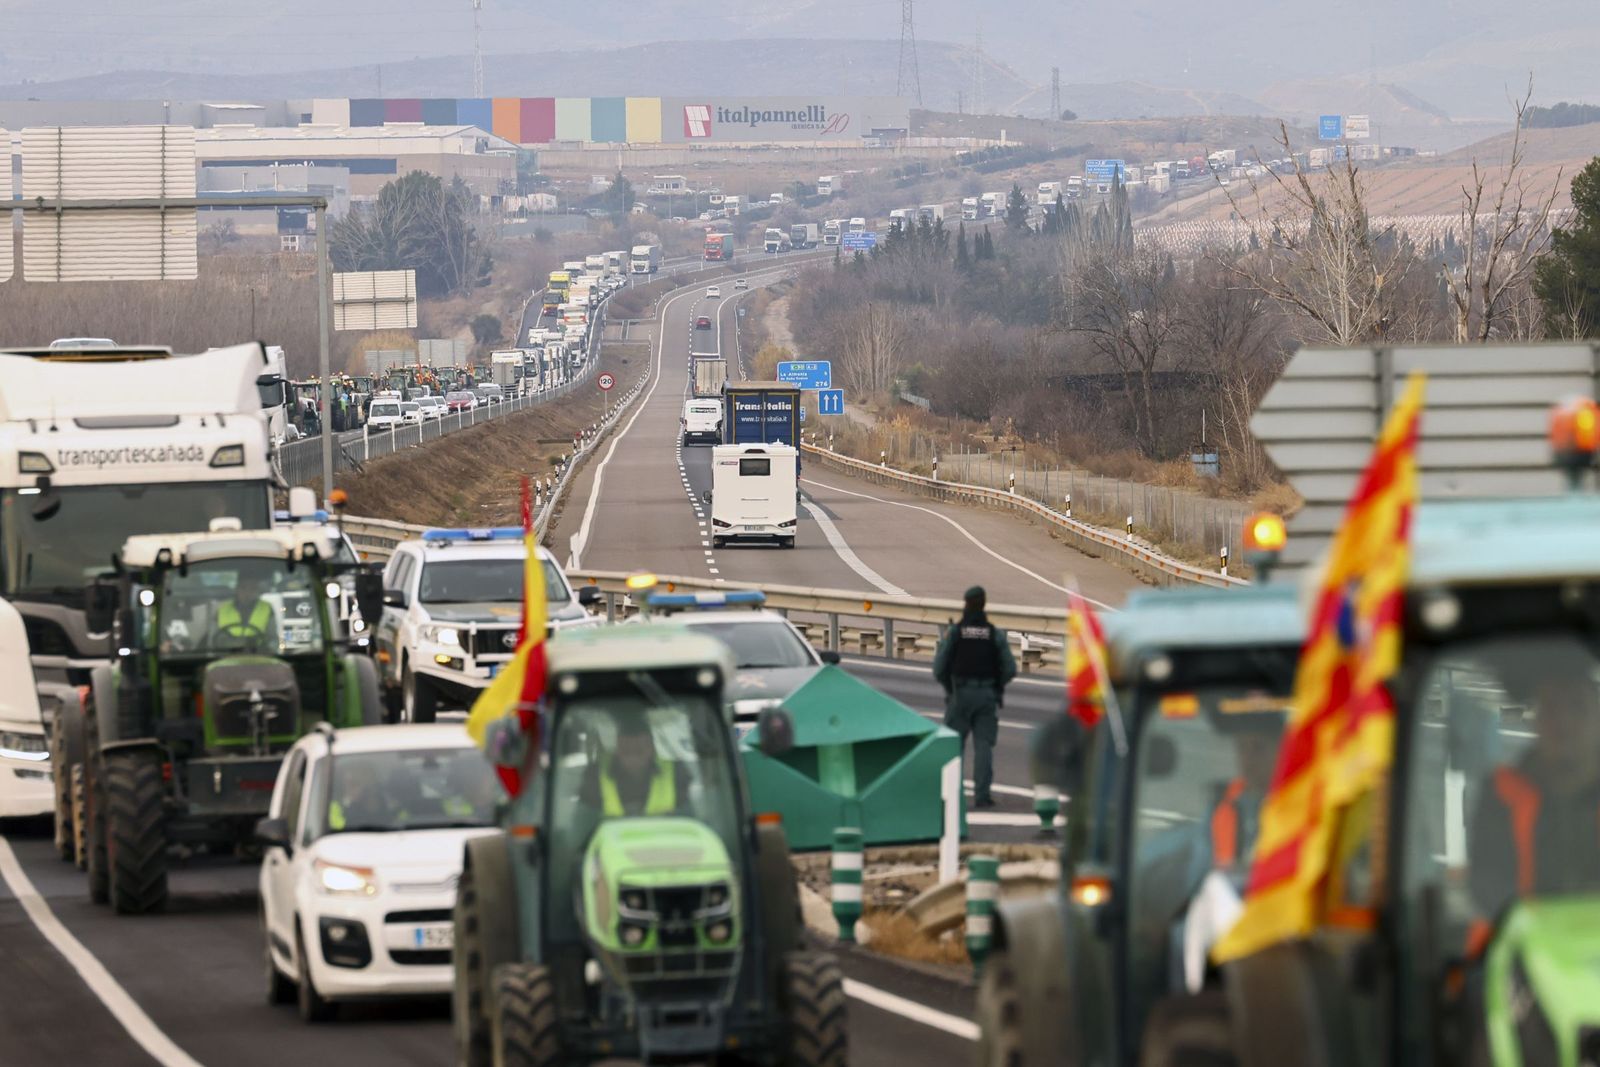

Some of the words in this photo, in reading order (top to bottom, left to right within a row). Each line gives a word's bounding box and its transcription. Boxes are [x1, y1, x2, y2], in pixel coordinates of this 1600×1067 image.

[718, 105, 825, 127] italpannelli
[820, 113, 850, 135] 20
[600, 377, 613, 385] 120
[58, 444, 205, 469] transportescañada
